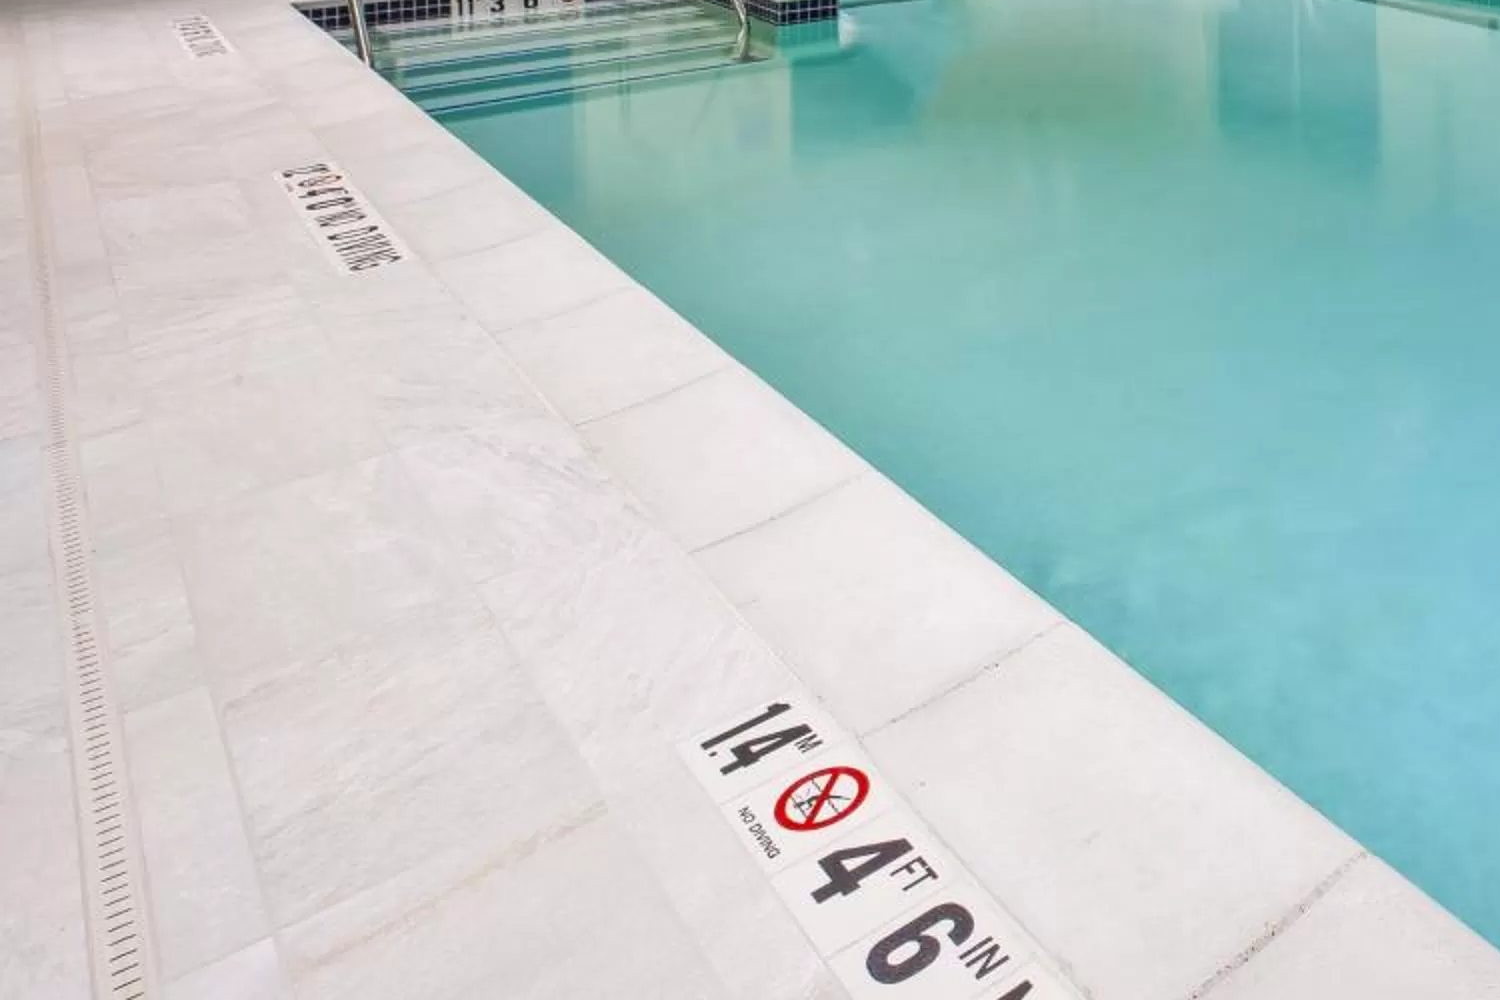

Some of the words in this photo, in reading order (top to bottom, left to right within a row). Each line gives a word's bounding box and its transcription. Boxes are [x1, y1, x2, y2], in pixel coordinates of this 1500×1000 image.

[738, 805, 756, 824] NO
[748, 823, 781, 859] DIVING
[810, 837, 913, 904] 4
[889, 856, 939, 892] FT
[865, 902, 975, 985] 6
[958, 936, 1010, 981] IN
